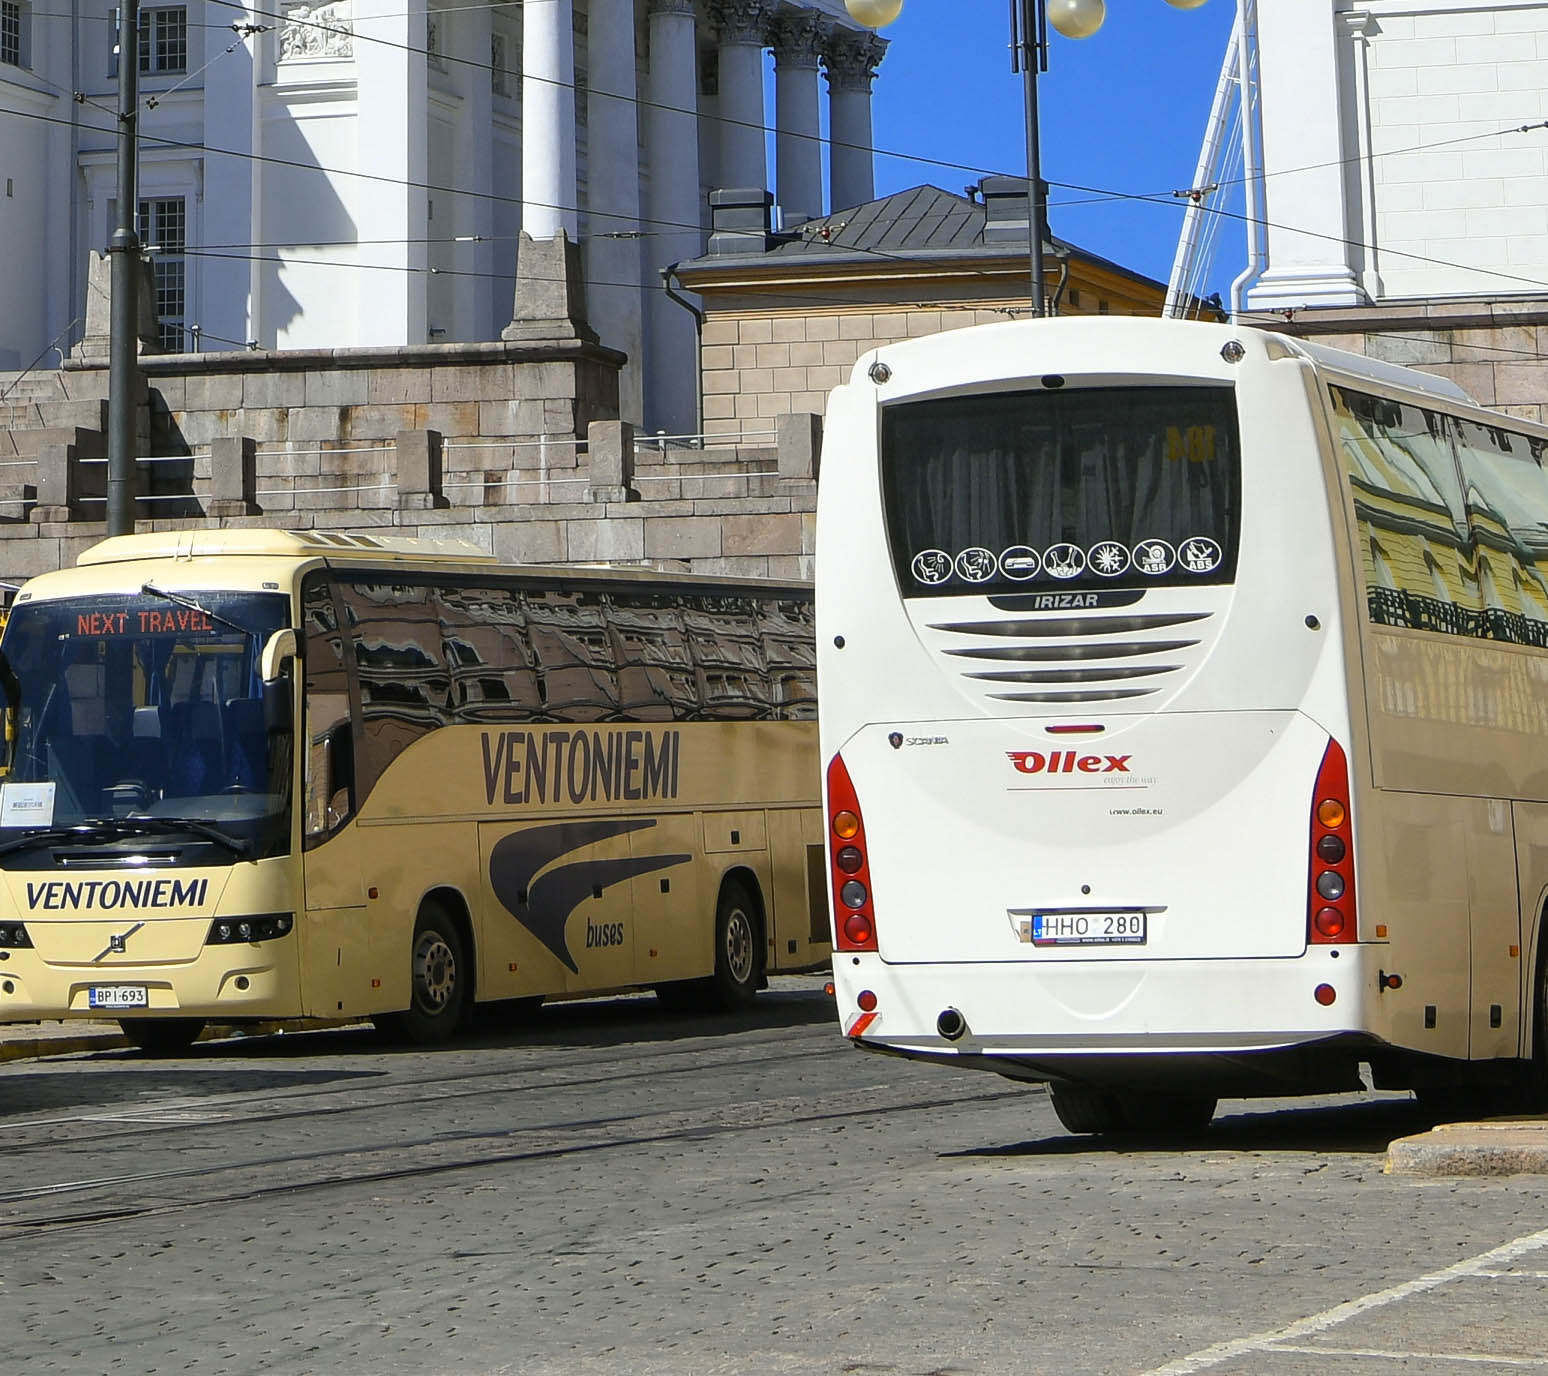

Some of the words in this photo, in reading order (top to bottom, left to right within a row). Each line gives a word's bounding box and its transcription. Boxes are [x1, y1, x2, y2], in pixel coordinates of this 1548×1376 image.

[1143, 563, 1166, 572] ASR
[1189, 559, 1213, 570] ABS
[1034, 593, 1098, 609] IRIZAR
[77, 611, 128, 636] NEXT
[137, 609, 213, 634] TRAVEL
[480, 729, 680, 806] VENTONIEMI
[1006, 750, 1133, 774] Ollex
[26, 878, 208, 910] VENTONIEMI
[586, 917, 624, 948] buses
[1045, 917, 1089, 936] HHO
[1103, 916, 1140, 935] 280
[97, 990, 144, 1003] BPI-693
